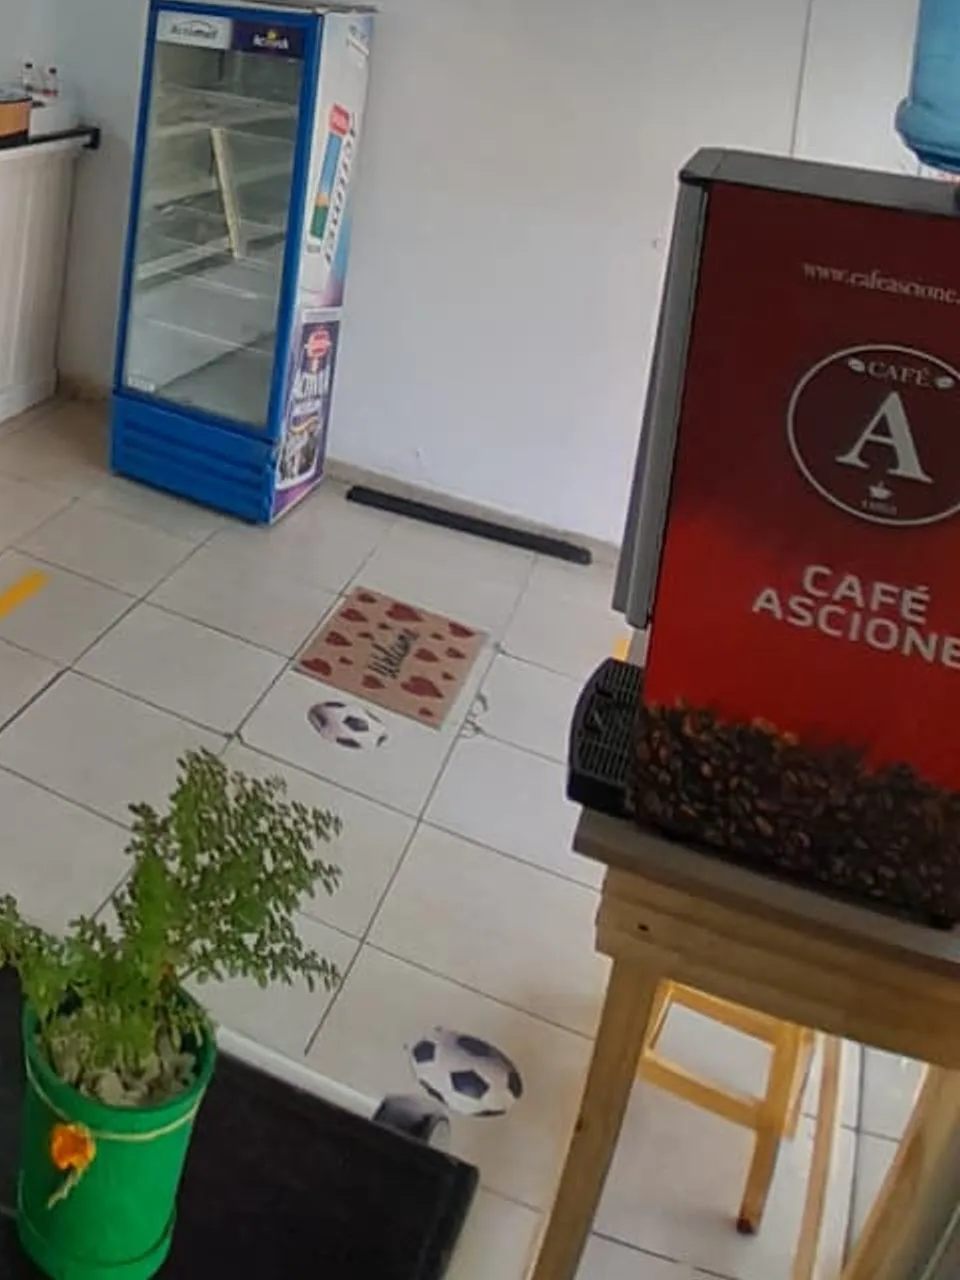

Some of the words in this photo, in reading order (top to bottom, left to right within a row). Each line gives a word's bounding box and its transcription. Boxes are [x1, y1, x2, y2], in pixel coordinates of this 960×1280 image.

[867, 361, 932, 388] CAFÉ
[835, 391, 934, 485] A
[751, 587, 960, 670] ASCIONE
[802, 564, 931, 625] CAFÉ
